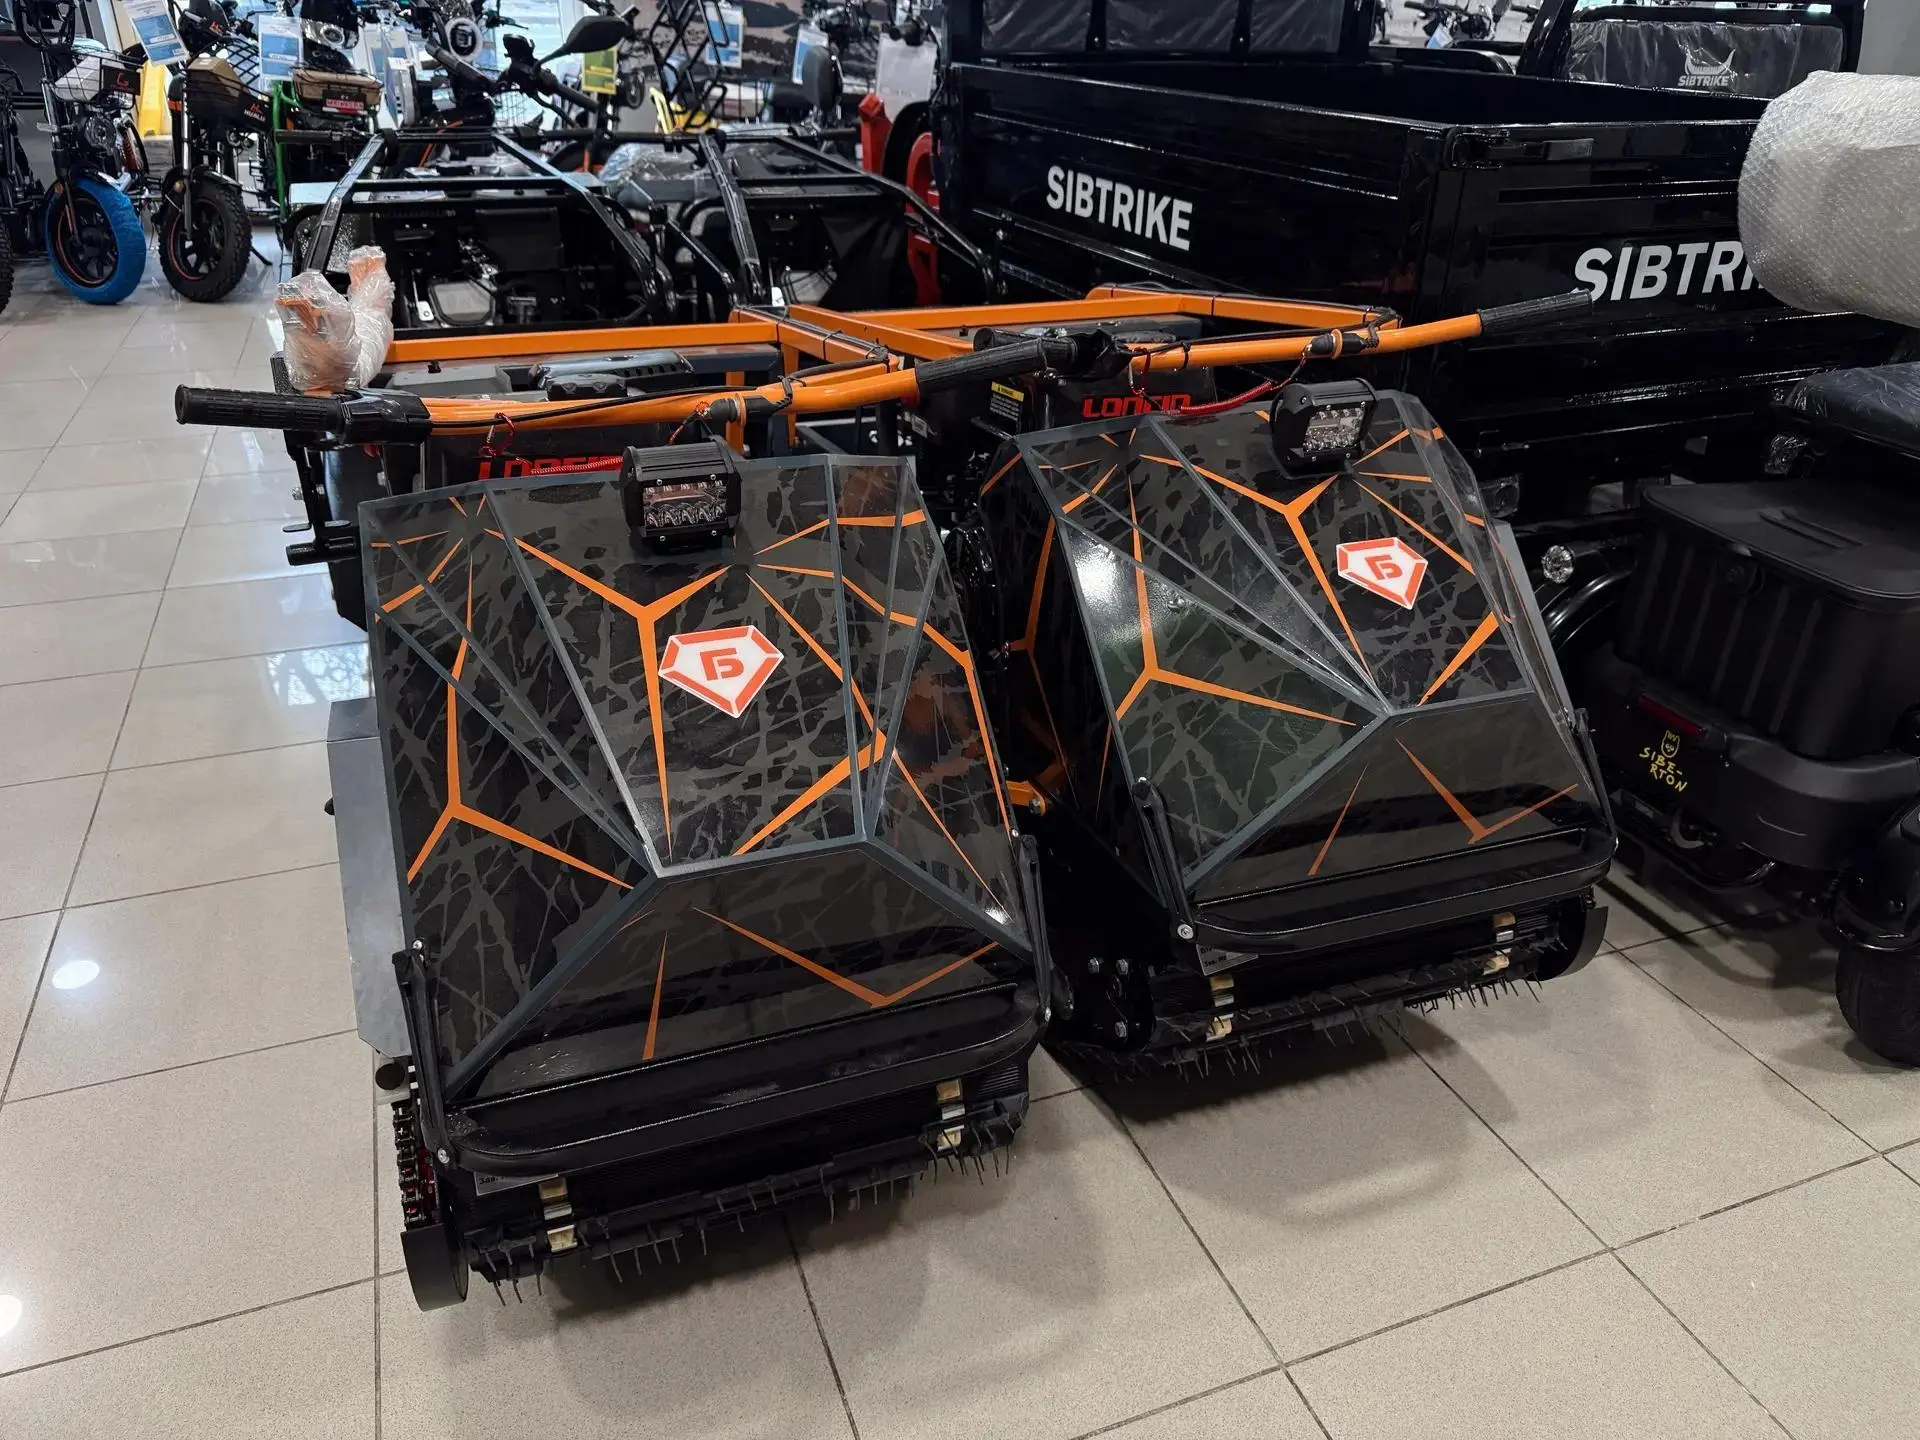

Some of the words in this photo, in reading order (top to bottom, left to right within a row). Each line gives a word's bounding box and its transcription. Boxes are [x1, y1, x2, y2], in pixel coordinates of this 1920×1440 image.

[1678, 75, 1730, 87] SIBTRIKE
[1046, 165, 1193, 251] SIBTRIKE
[1574, 241, 1765, 302] SIBTR
[1650, 763, 1688, 792] RTON
